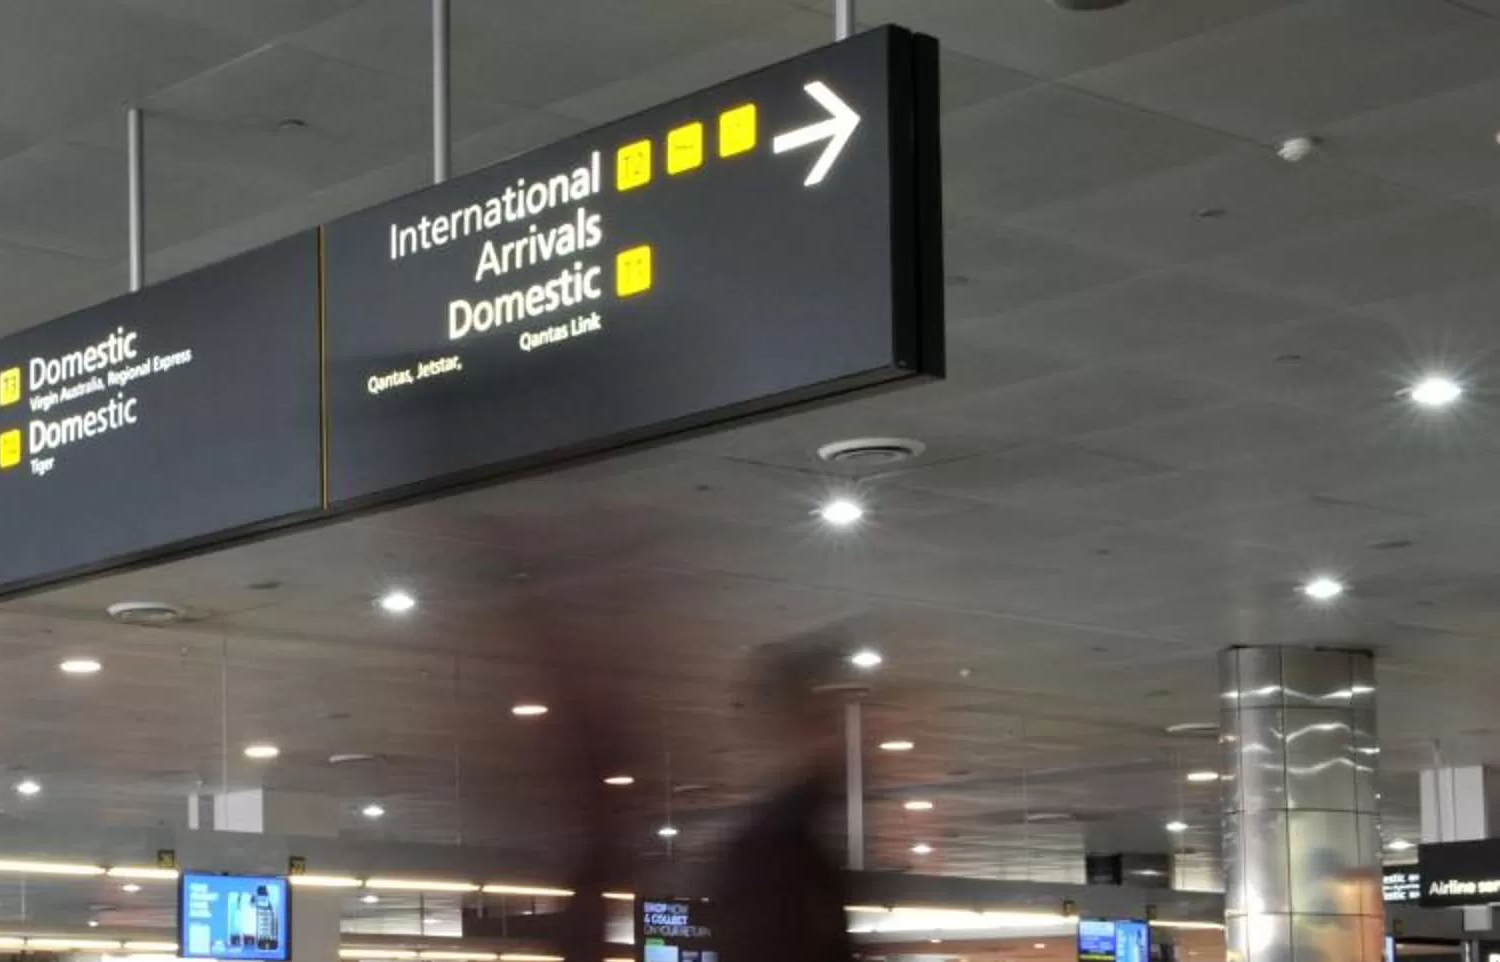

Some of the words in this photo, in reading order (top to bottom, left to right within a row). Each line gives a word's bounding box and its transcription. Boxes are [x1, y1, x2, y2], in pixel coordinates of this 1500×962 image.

[390, 150, 601, 259] International
[475, 207, 602, 283] Arrivals
[449, 265, 602, 340] Domestic
[519, 323, 569, 351] Qantas
[571, 312, 602, 336] Link
[30, 326, 137, 391] Domestic
[30, 391, 59, 412] Virgin
[107, 357, 151, 387] Regional
[153, 348, 193, 373] Express
[367, 368, 414, 394] Qantas,
[416, 355, 463, 379] Jetstar,
[30, 392, 137, 454] Domestic
[30, 457, 55, 476] Tiger
[1428, 879, 1476, 896] Airline
